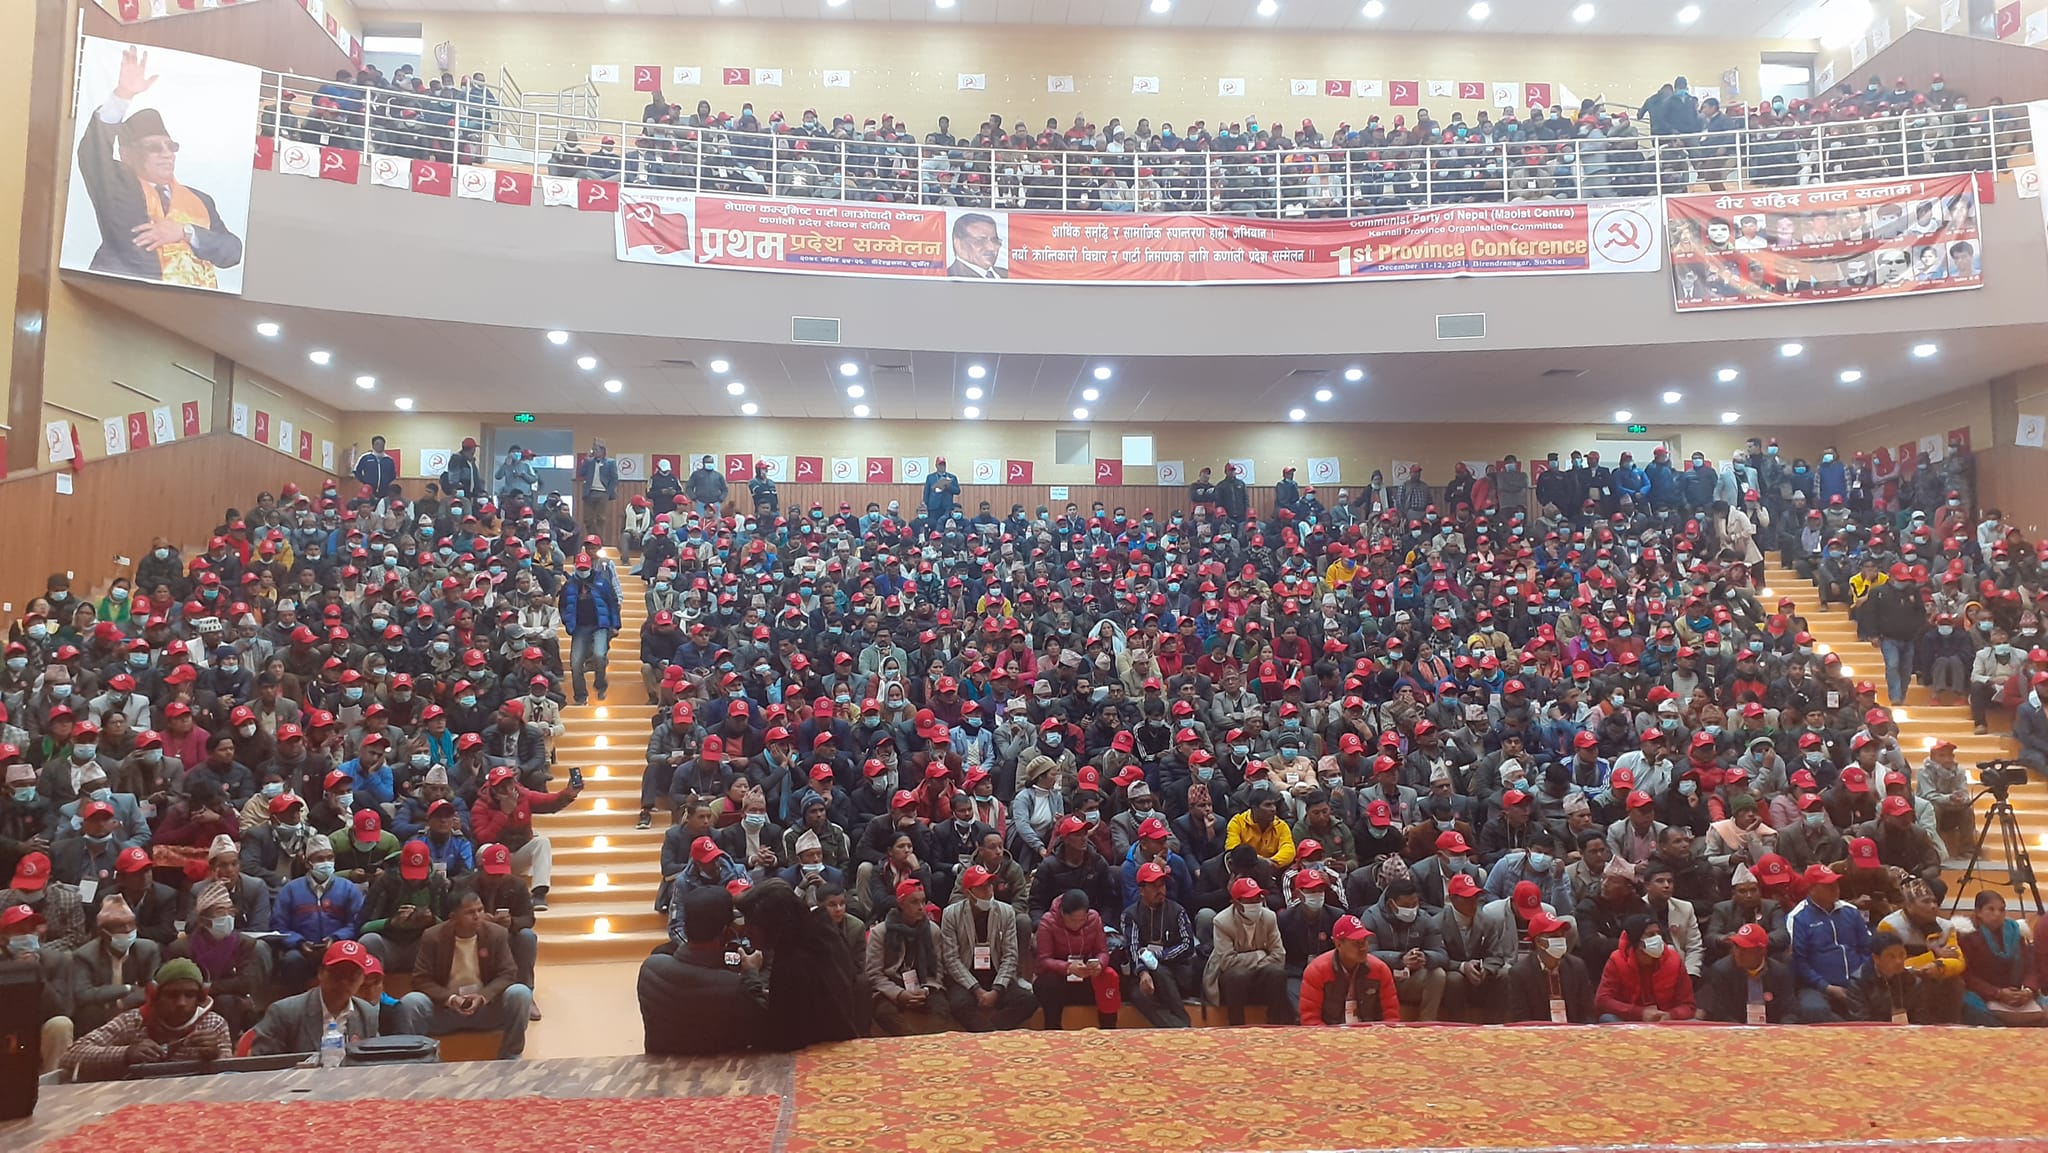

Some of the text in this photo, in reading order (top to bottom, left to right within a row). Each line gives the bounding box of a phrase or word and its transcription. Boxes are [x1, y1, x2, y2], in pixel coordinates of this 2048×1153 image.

[1714, 195, 1745, 210] वीर
[1751, 192, 1801, 209] सहिद
[1807, 189, 1849, 204] लाल
[1854, 182, 1912, 199] सलाम
[724, 200, 756, 213] नेपाल
[815, 207, 838, 218] पार्टी
[1350, 207, 1575, 228] Communist Party of Nepal (Maoist Centre)
[798, 218, 821, 228] प्रदेश
[860, 221, 891, 231] समिति
[1051, 222, 1081, 239] आर्थिक
[1113, 226, 1119, 240] र
[1123, 223, 1162, 240] सामाजिक
[1368, 222, 1564, 238] Karnali Province Organisation Committee
[699, 227, 943, 263] प्रथम प्रदेश सम्मेलन
[1082, 246, 1108, 264] विचार
[1112, 251, 1119, 264] र
[1122, 247, 1141, 263] पार्टी
[1188, 246, 1209, 262] लागि
[1213, 247, 1245, 263] कर्णाली
[1248, 248, 1268, 264] प्रदेश
[1272, 247, 1305, 263] सम्मेलन
[1329, 237, 1588, 277] 1st Province Conference
[1378, 262, 1418, 272] December
[1534, 257, 1566, 266] Surkhet
